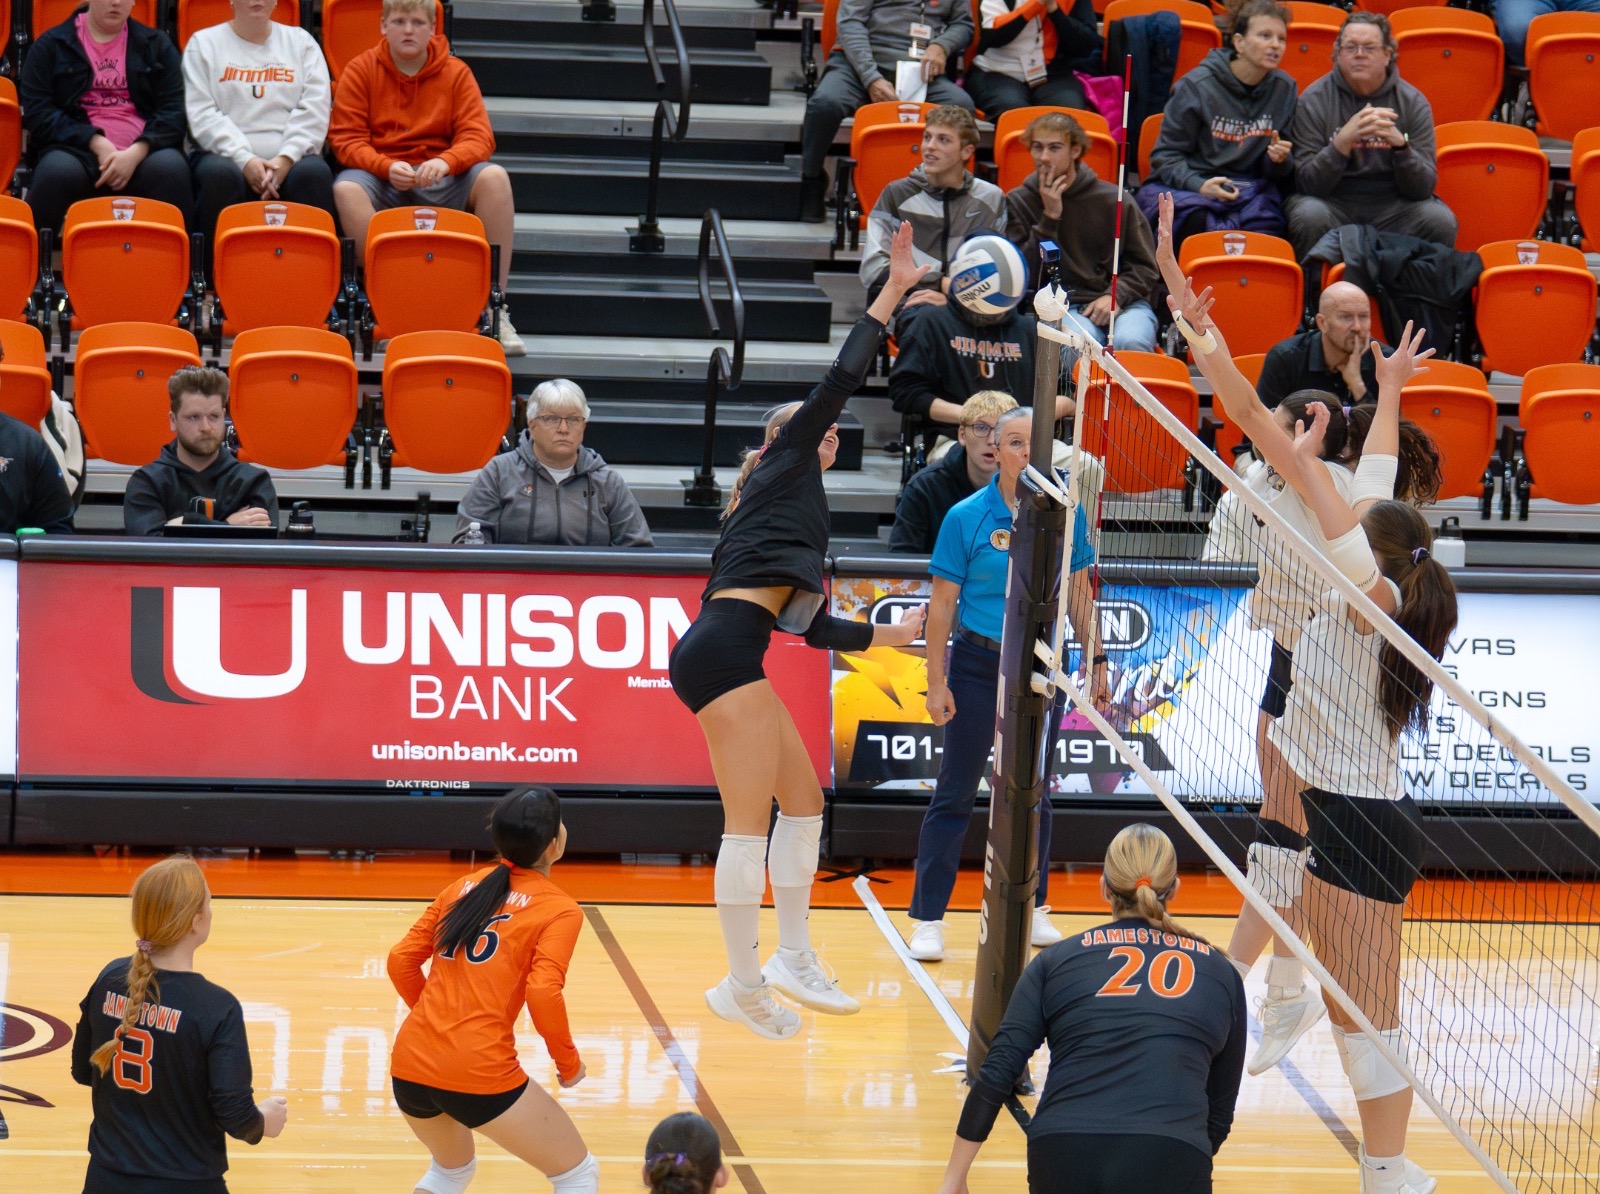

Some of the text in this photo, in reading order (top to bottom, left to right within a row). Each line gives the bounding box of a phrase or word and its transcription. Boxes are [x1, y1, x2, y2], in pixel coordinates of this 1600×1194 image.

[219, 66, 295, 83] JIMMIES
[950, 335, 1023, 358] JIMMIE
[410, 675, 577, 722] BANK
[372, 740, 578, 763] unisonbank.com
[386, 779, 470, 789] DAKTRONICS
[1450, 771, 1588, 791] DECAS
[1081, 928, 1210, 956] JAMESTOWN
[1095, 946, 1195, 999] 20
[103, 991, 182, 1034] JAMTOWN
[113, 1024, 154, 1095] 8
